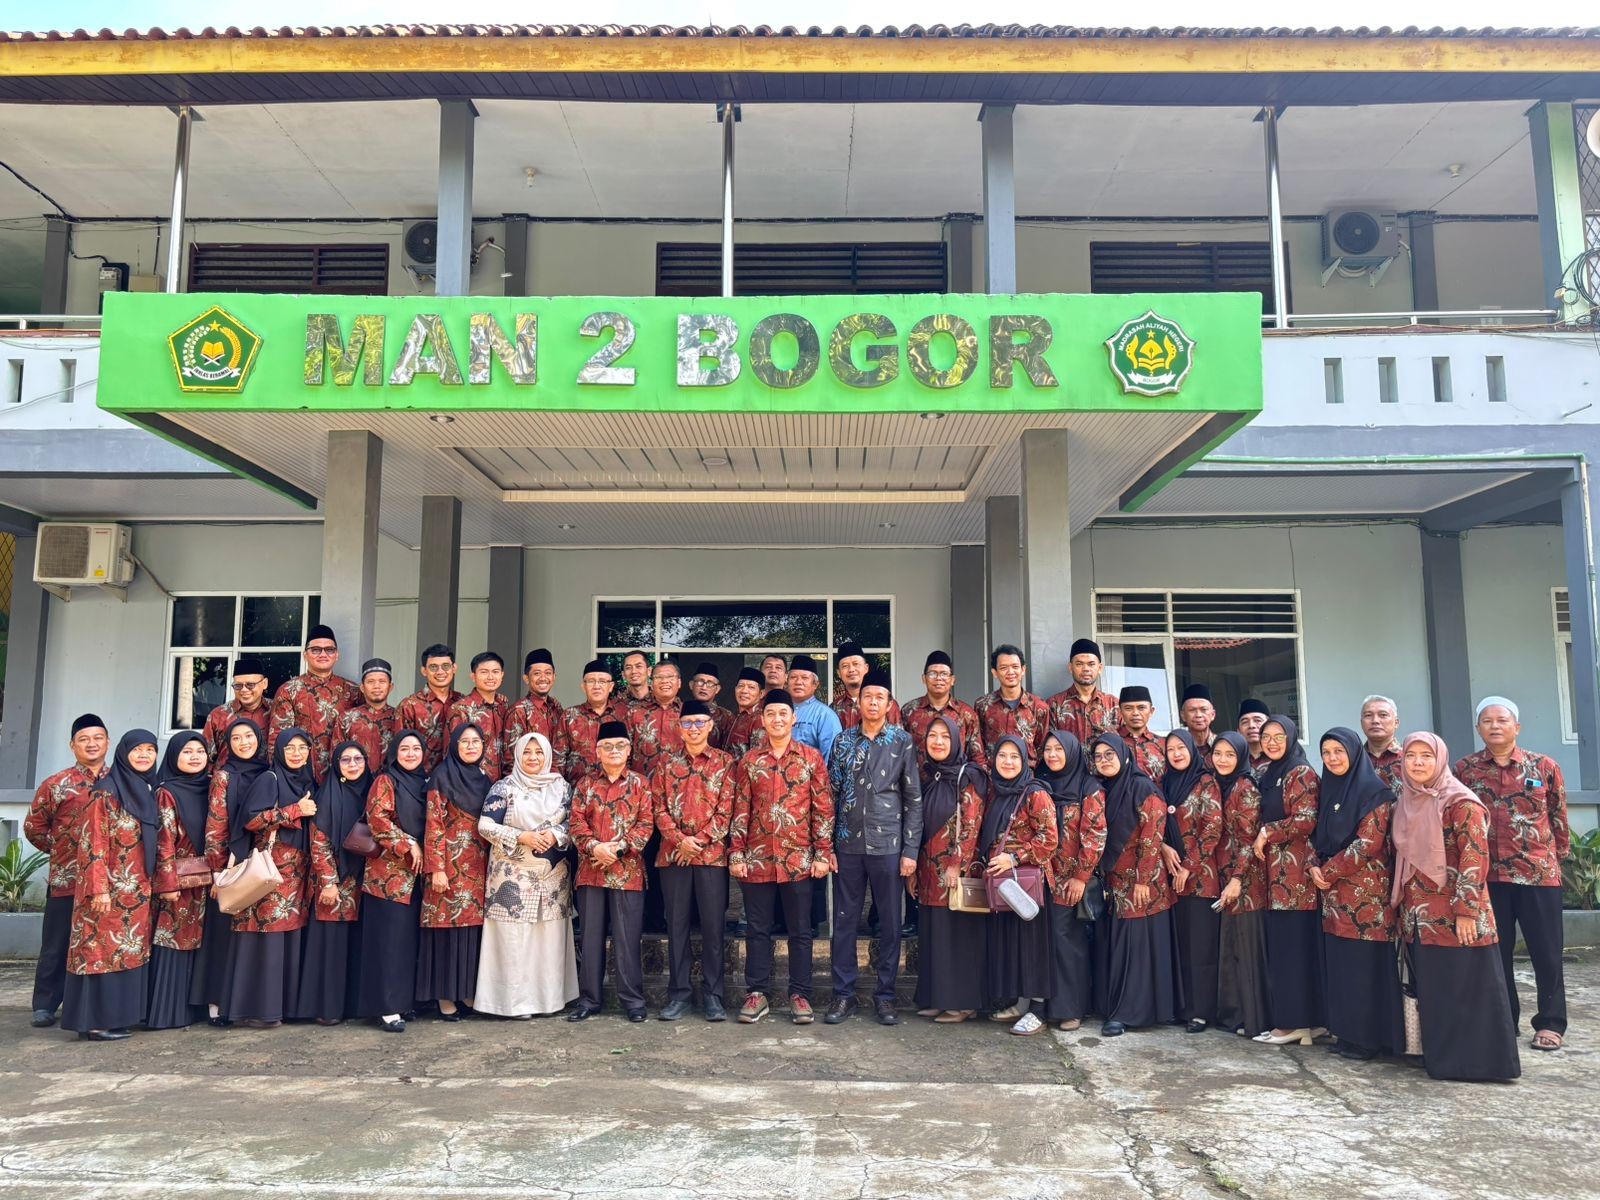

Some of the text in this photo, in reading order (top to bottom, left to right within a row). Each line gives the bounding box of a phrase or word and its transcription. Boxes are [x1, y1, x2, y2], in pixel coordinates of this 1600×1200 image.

[304, 311, 1060, 389] MAN 2 BOGOR
